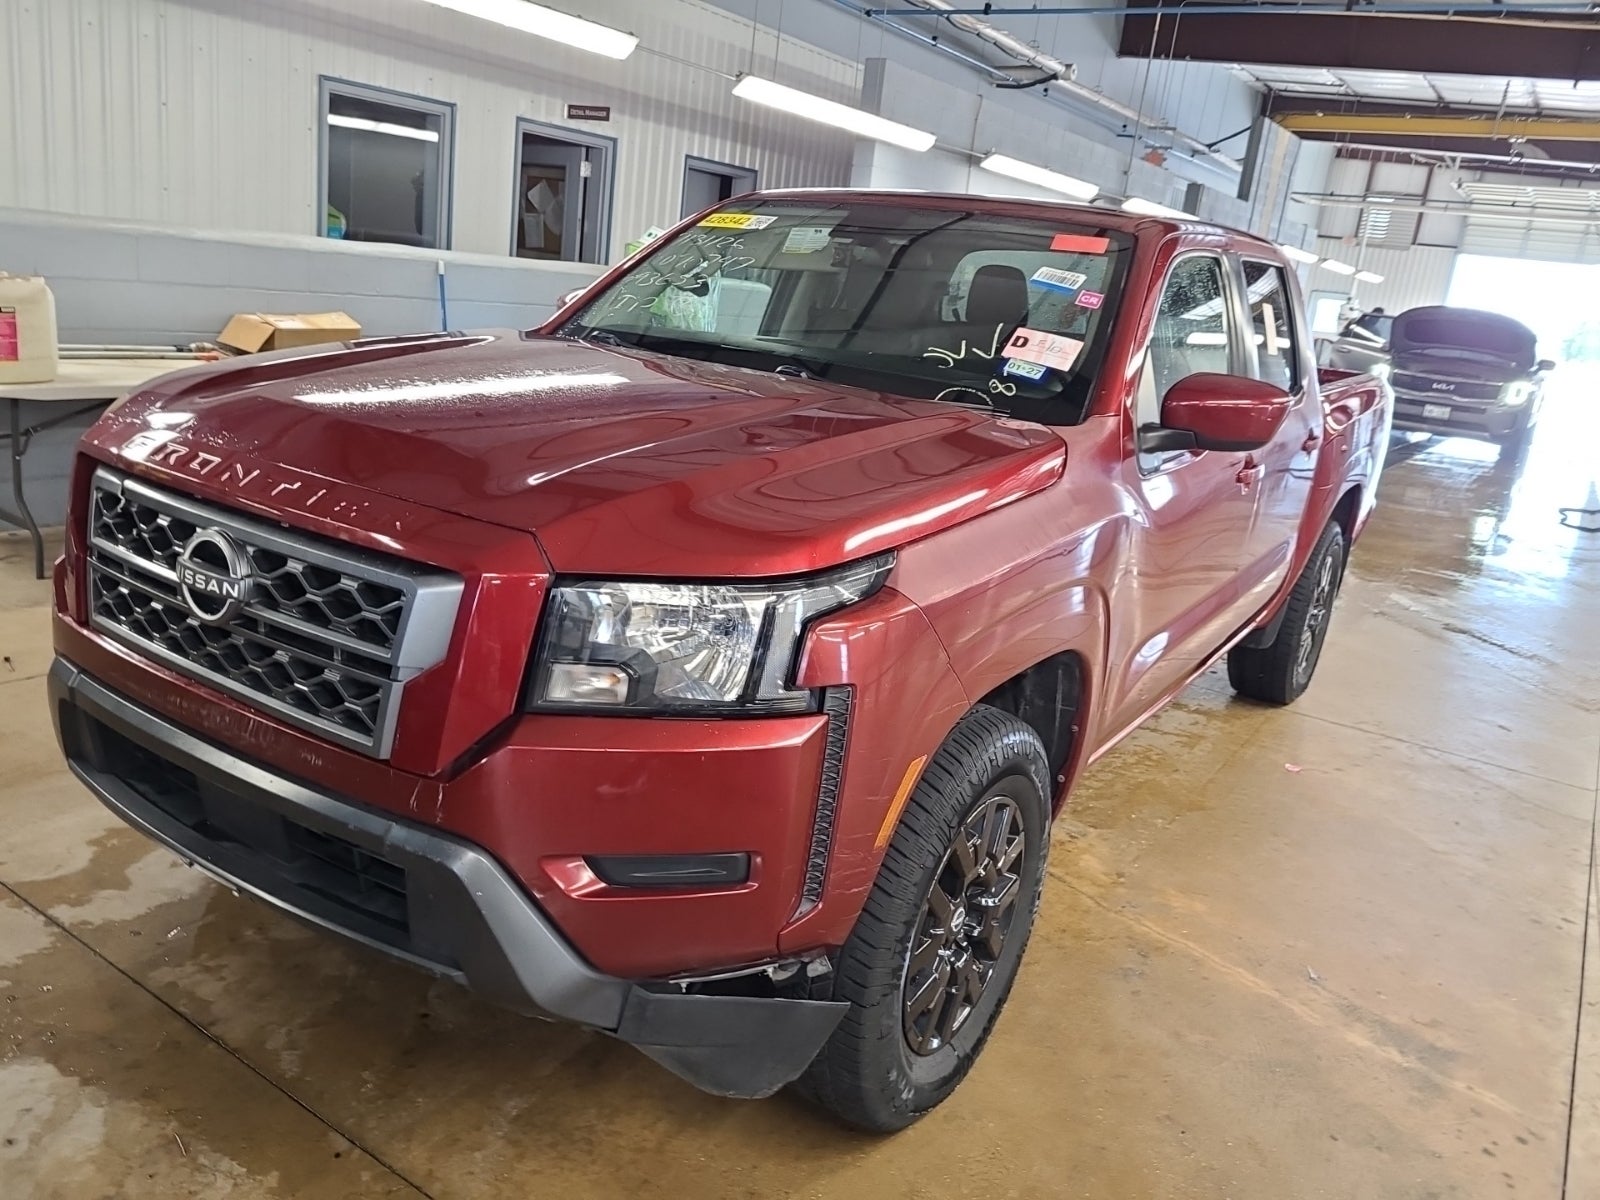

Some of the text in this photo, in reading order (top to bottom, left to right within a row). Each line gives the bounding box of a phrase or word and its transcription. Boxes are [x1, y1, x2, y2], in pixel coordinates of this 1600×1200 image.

[1080, 294, 1100, 305] CR
[1010, 335, 1030, 349] D
[123, 434, 410, 533] FRONTI
[177, 564, 239, 598] NISSAN
